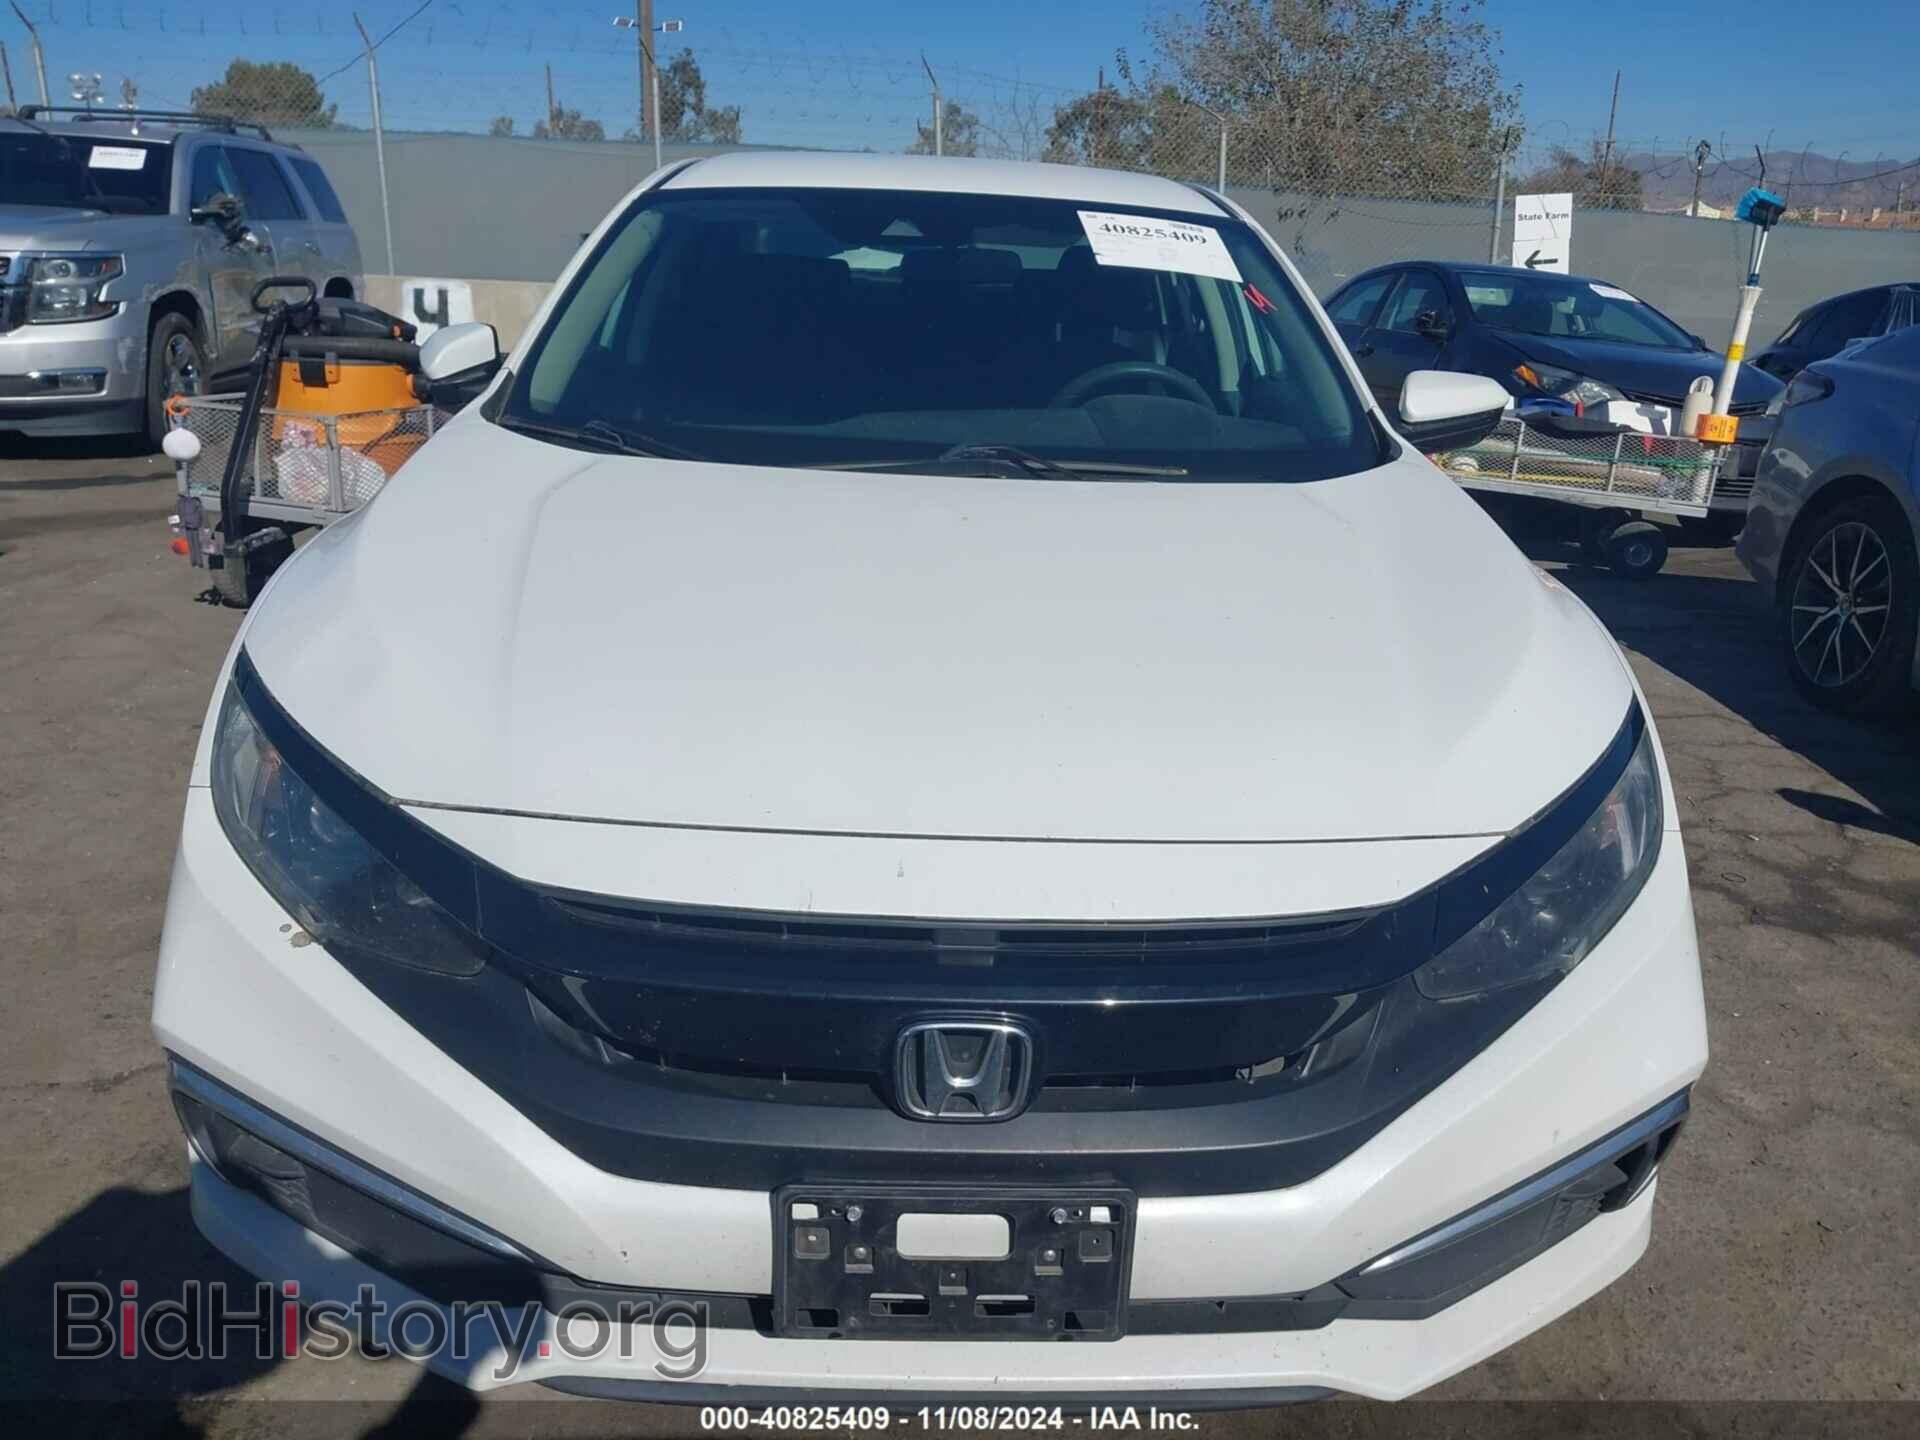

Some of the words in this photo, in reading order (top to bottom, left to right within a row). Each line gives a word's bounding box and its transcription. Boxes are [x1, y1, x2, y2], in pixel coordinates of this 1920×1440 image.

[1518, 213, 1543, 222] State
[1545, 211, 1569, 220] Farm
[1098, 222, 1208, 245] 40825409
